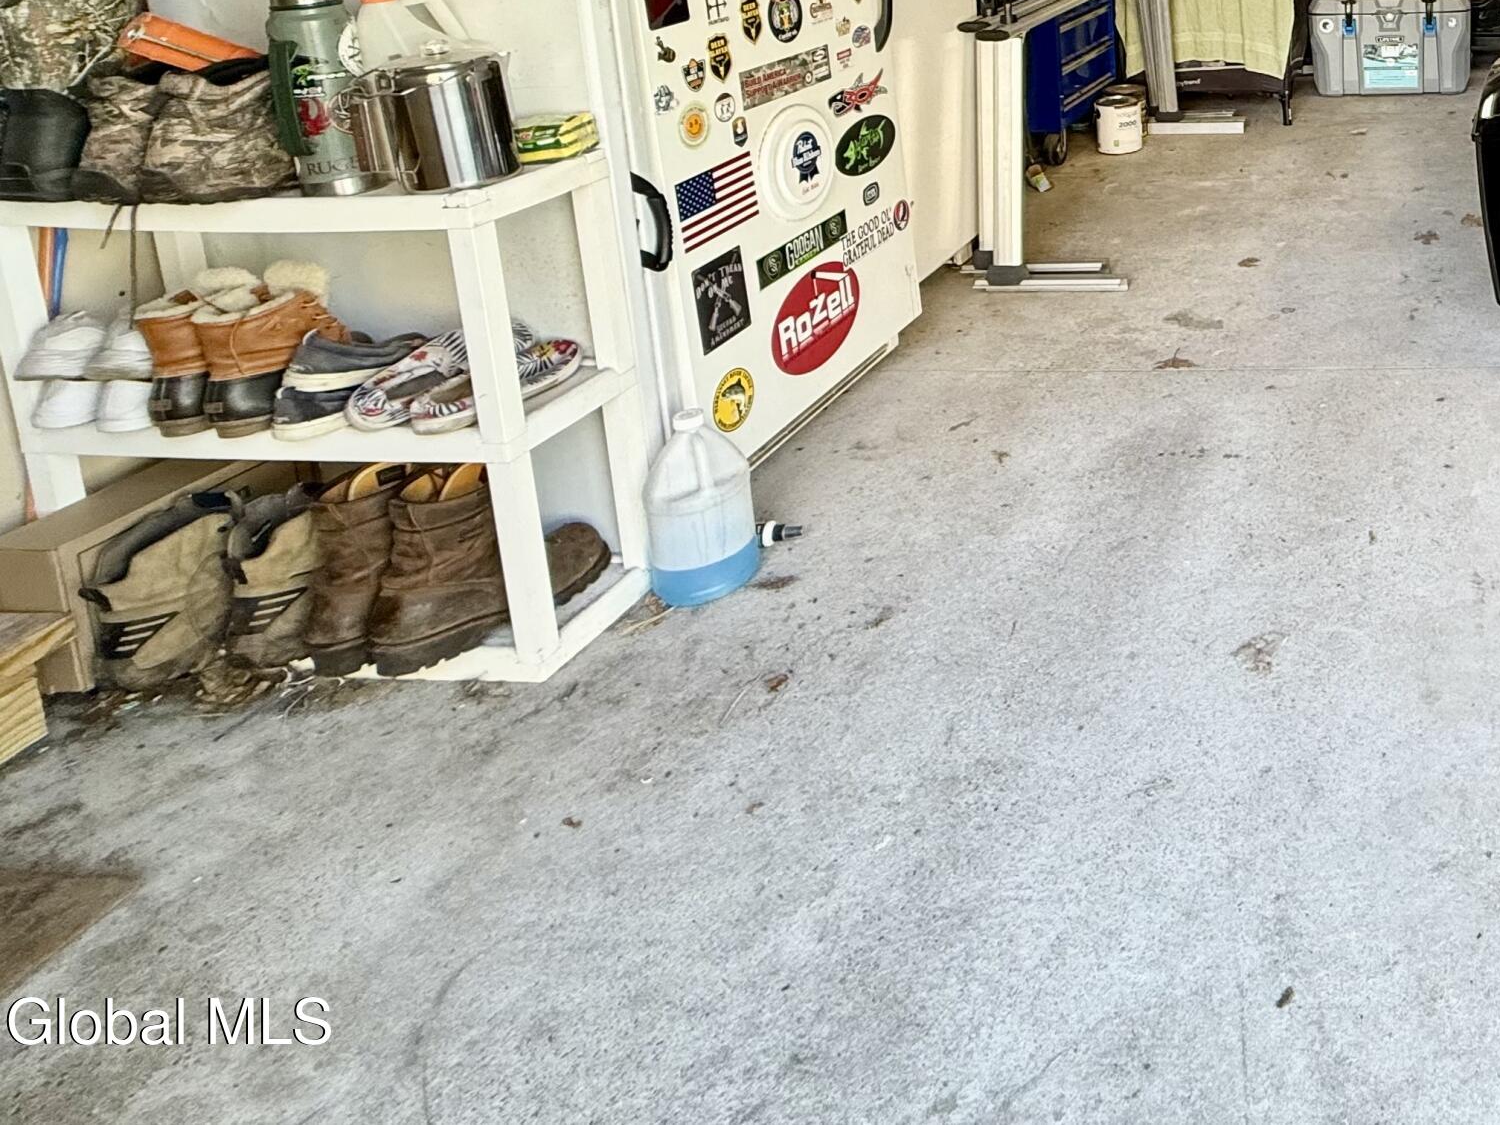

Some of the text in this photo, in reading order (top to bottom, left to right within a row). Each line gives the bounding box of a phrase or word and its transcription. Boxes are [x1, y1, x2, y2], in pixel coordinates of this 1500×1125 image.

[306, 158, 357, 175] RUGE
[840, 233, 856, 250] THE
[857, 218, 881, 240] GOOD
[842, 224, 895, 267] GRATEFUL DEAD
[785, 224, 824, 270] GOOGAN
[718, 261, 743, 278] TREAD
[721, 275, 734, 292] ME
